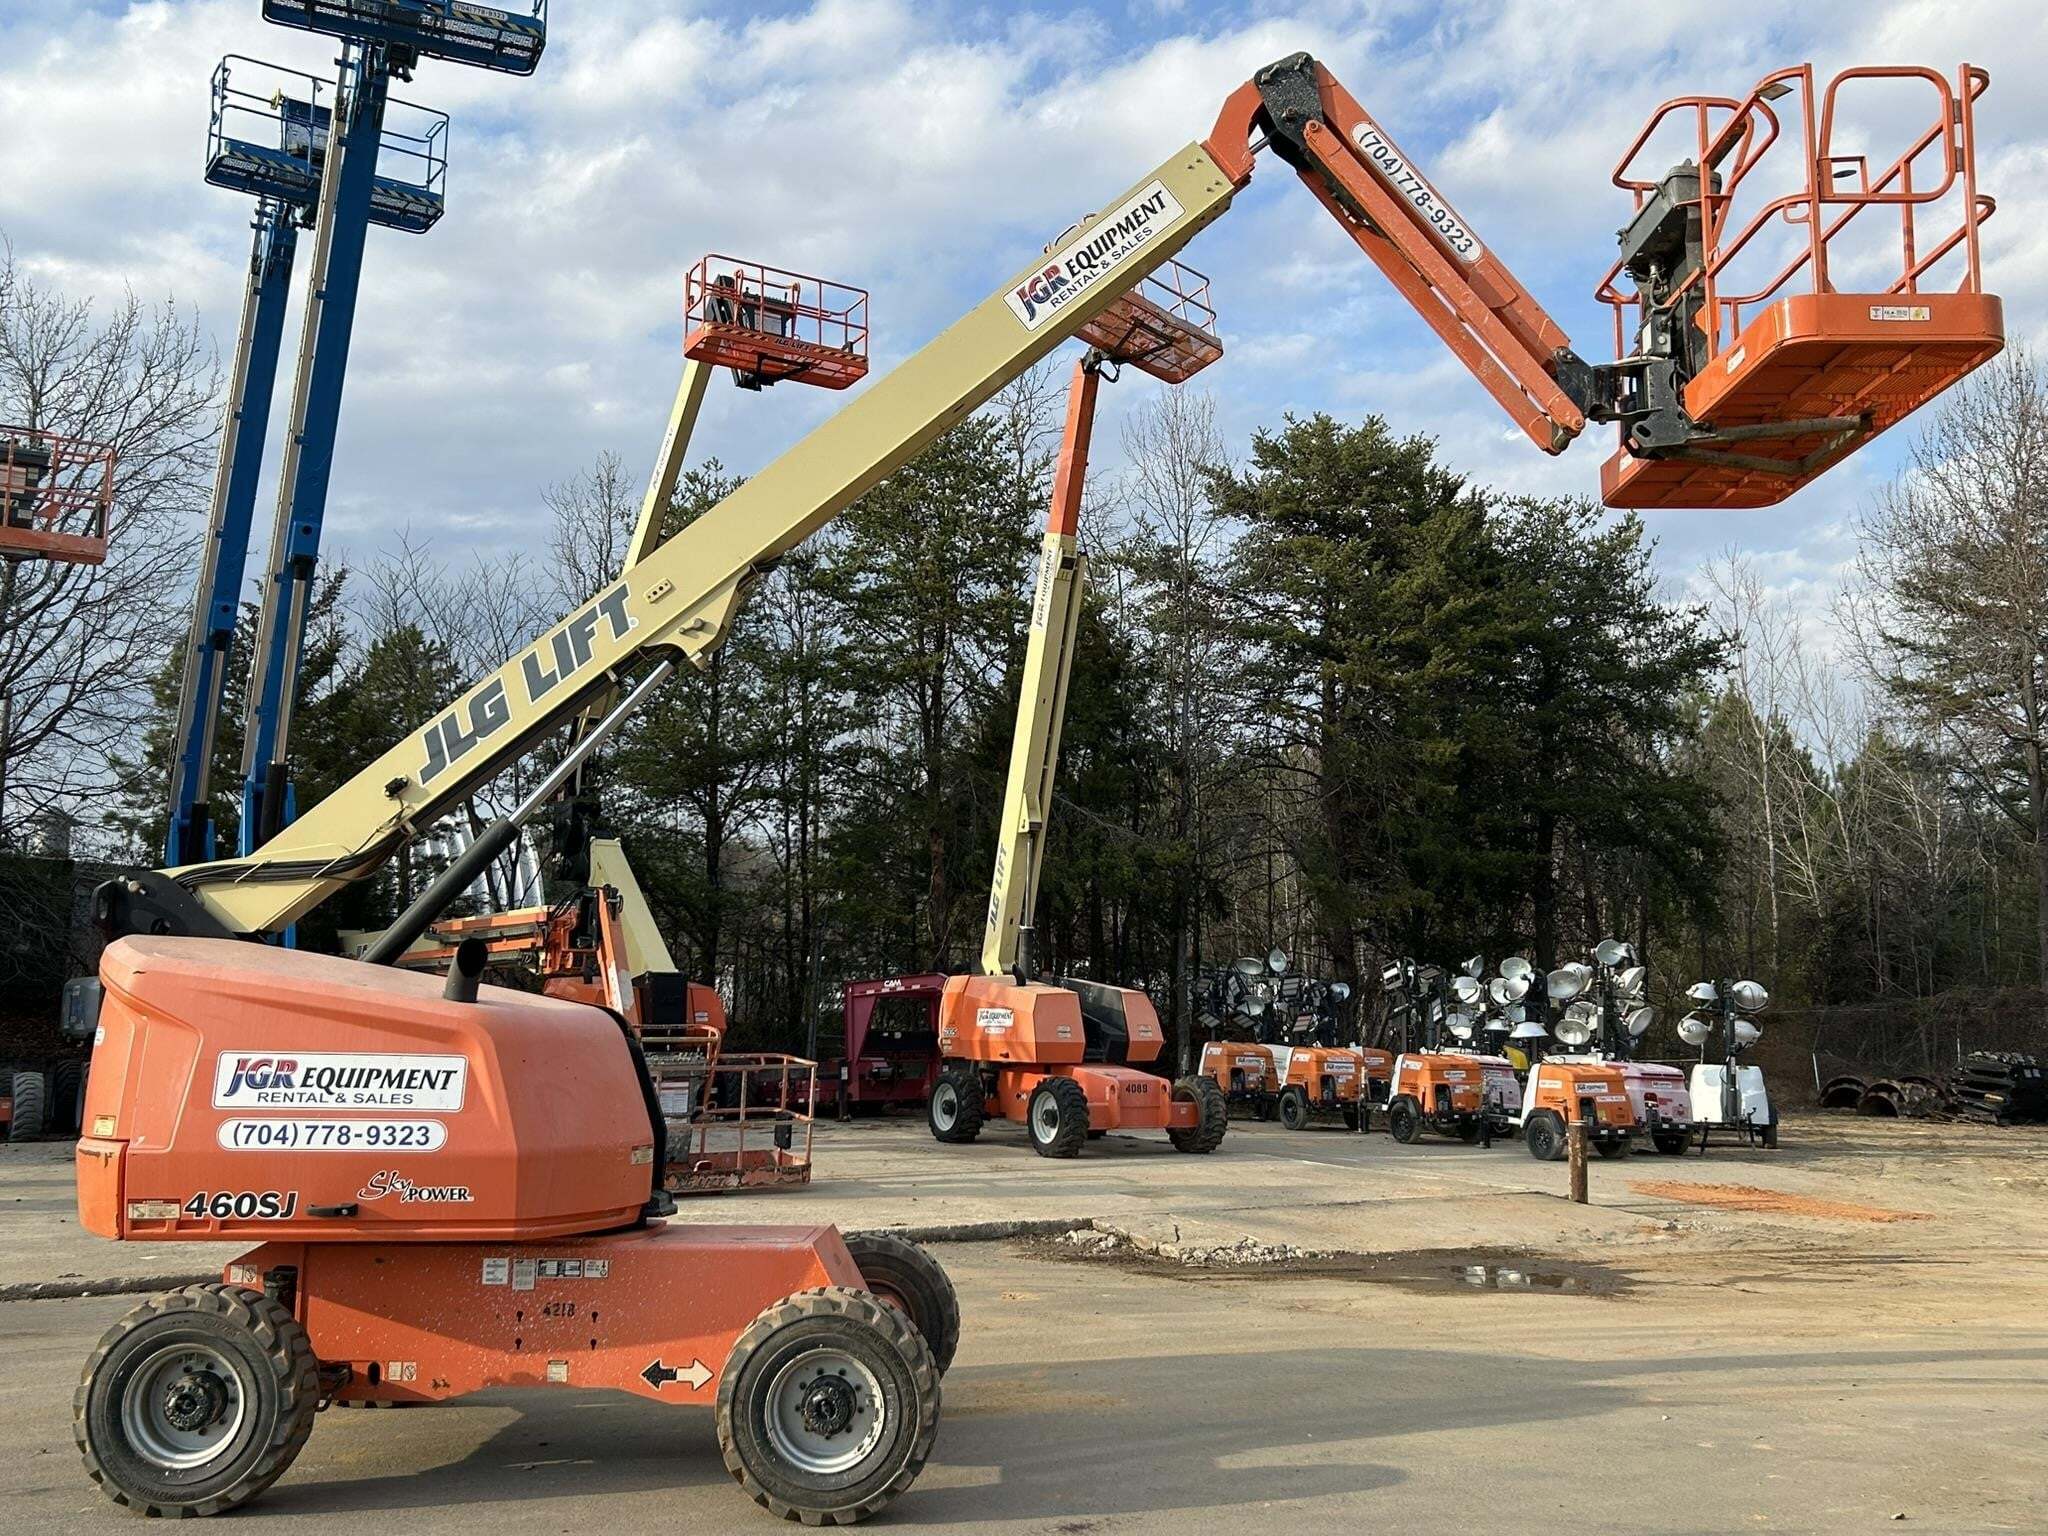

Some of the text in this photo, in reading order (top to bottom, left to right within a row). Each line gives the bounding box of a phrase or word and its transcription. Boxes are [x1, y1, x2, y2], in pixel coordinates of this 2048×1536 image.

[1016, 190, 1167, 322] JGR EQUIPMENT
[1050, 226, 1153, 309] RENTAL & SALES
[417, 581, 632, 786] JLG LIFT
[988, 842, 1007, 933] JLG LIFT
[223, 1058, 457, 1097] JGR EQUIPMENT
[257, 1092, 414, 1105] RENTAL & SALES
[183, 1191, 299, 1220] 460SJ
[357, 1169, 469, 1203] Sky POWER
